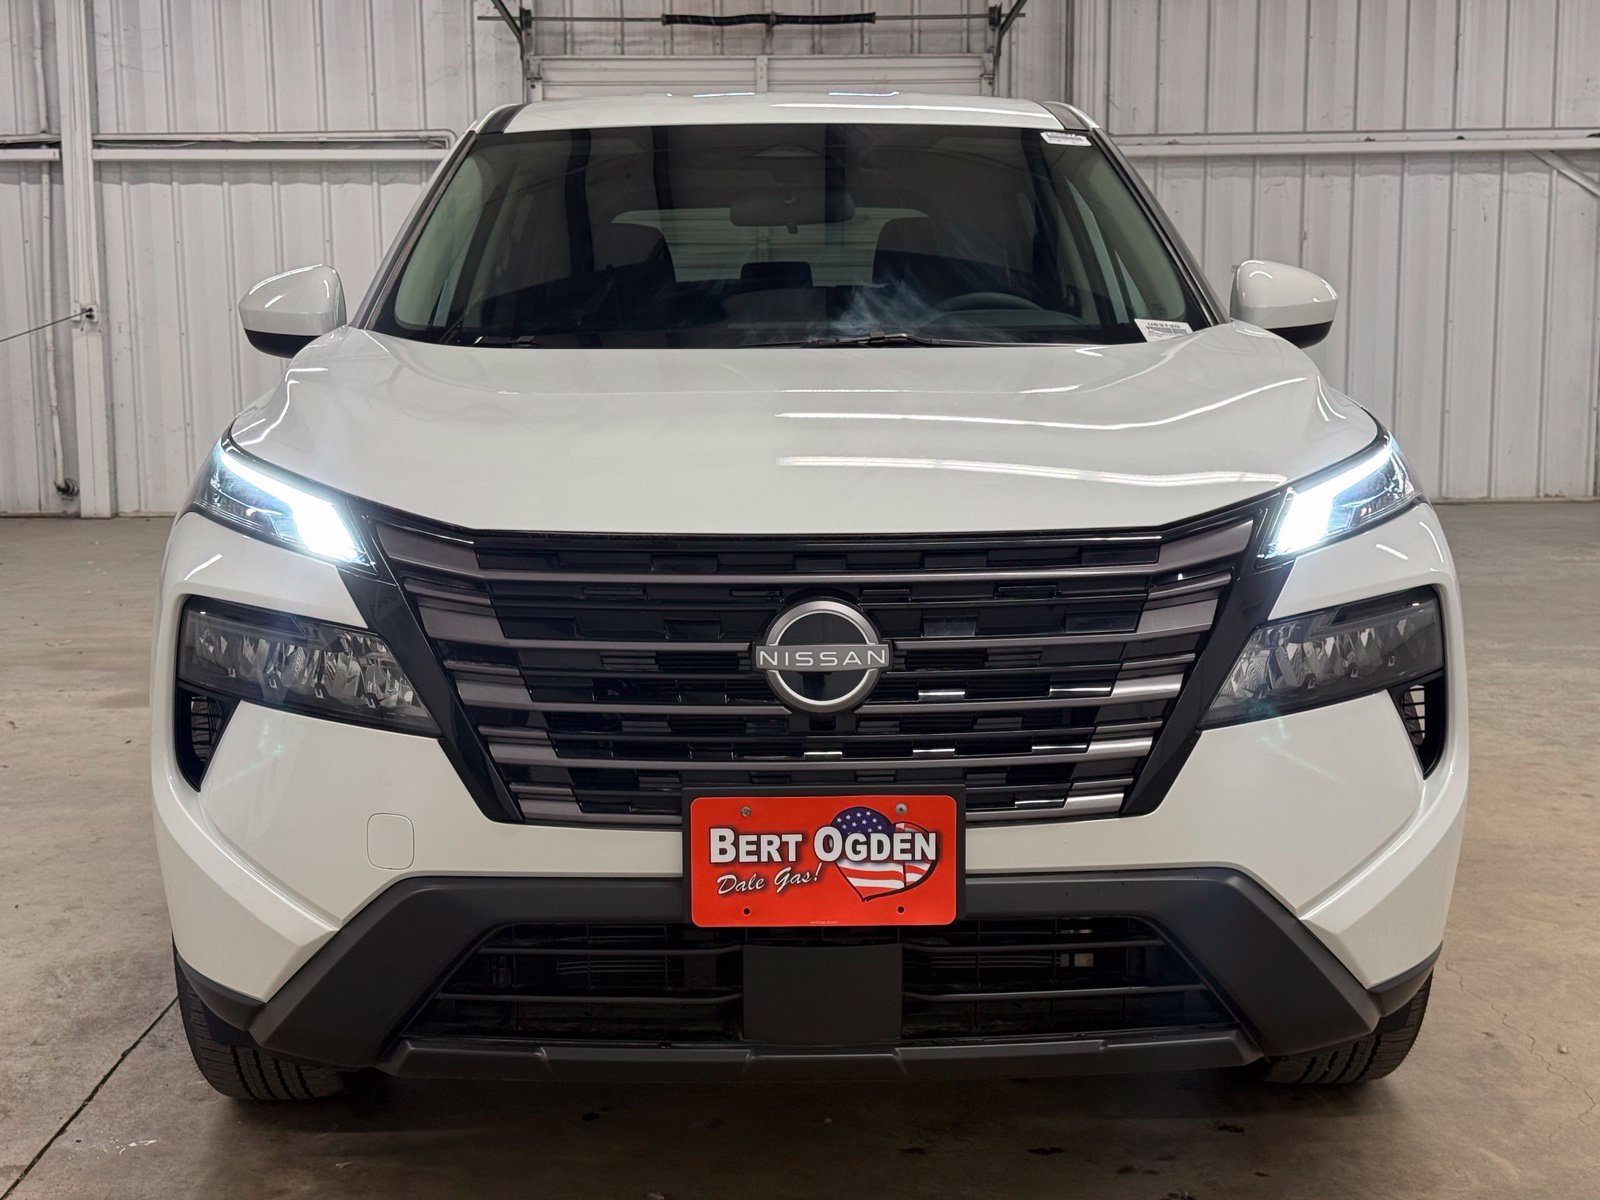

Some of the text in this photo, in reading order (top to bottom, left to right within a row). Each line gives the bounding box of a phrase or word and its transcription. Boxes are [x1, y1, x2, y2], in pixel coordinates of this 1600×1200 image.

[760, 649, 885, 666] NISSAN
[709, 826, 936, 864] BERT OGDEN
[717, 863, 823, 895] Dale Gas!
